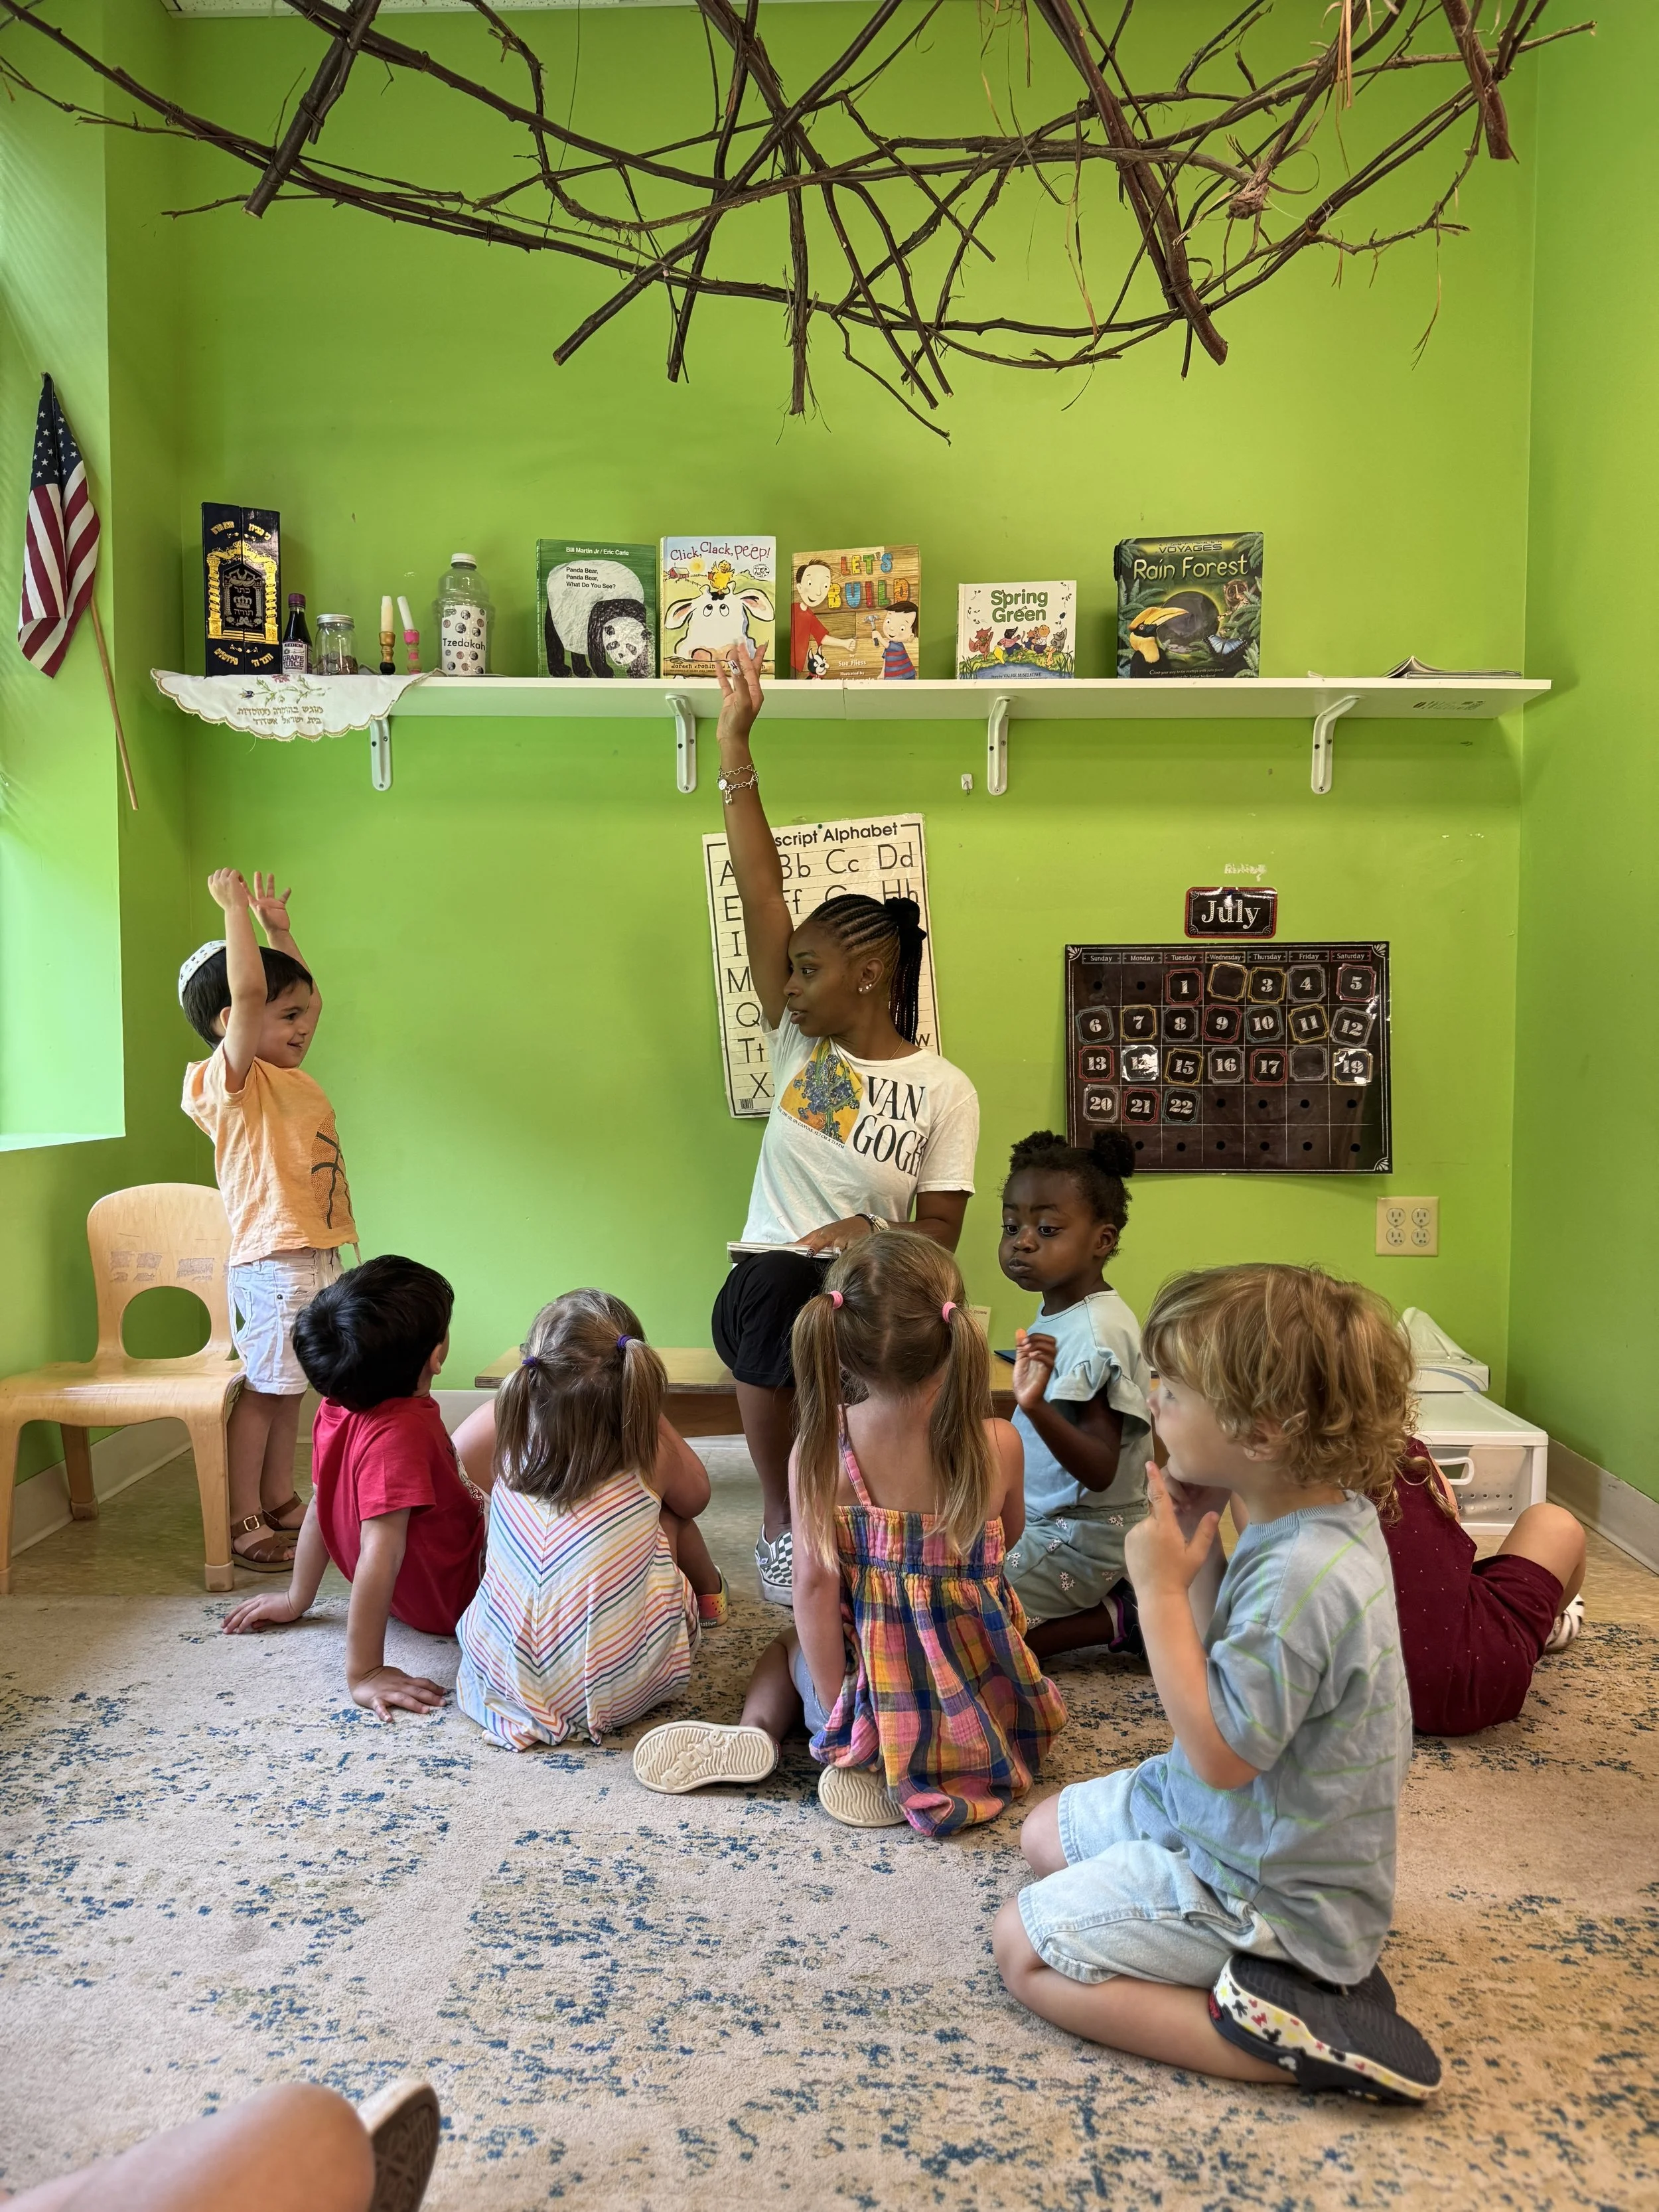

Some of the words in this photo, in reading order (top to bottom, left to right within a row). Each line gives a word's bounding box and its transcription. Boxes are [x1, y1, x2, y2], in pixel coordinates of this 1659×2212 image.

[670, 546, 702, 561] Click,
[700, 542, 733, 557] Clack,
[1159, 544, 1222, 553] VOYAGES
[841, 552, 893, 575] LET'S
[1133, 559, 1175, 580] Rain
[1182, 554, 1249, 578] Forest
[828, 578, 909, 609] BUILD
[991, 589, 1048, 609] Spring
[992, 607, 1046, 623] Green
[442, 638, 486, 651] Tzedakah
[824, 822, 898, 843] Alphabet
[826, 848, 859, 873] Cc
[878, 842, 914, 869] Dd
[1201, 899, 1261, 929] July
[727, 966, 751, 993] M
[1180, 980, 1189, 994] 1
[1261, 978, 1273, 992] 3
[1299, 976, 1313, 991] 4
[1350, 976, 1362, 990] 5
[736, 1002, 760, 1027] Q
[1089, 1019, 1102, 1033] 6
[1133, 1015, 1145, 1029] 7
[1174, 1017, 1187, 1031] 8
[1216, 1016, 1228, 1030] 9
[1252, 1015, 1274, 1031] 10
[1299, 1015, 1320, 1032] 11
[1339, 1019, 1363, 1037] 12
[737, 1037, 764, 1063] Tt
[1087, 1056, 1107, 1070] 13
[1173, 1059, 1195, 1074] 15
[1216, 1058, 1236, 1072] 16
[1259, 1060, 1280, 1074] 17
[1341, 1060, 1364, 1074] 19
[867, 1075, 926, 1124] VAN
[1090, 1096, 1112, 1111] 20
[1130, 1099, 1151, 1114] 21
[1169, 1098, 1193, 1114] 22
